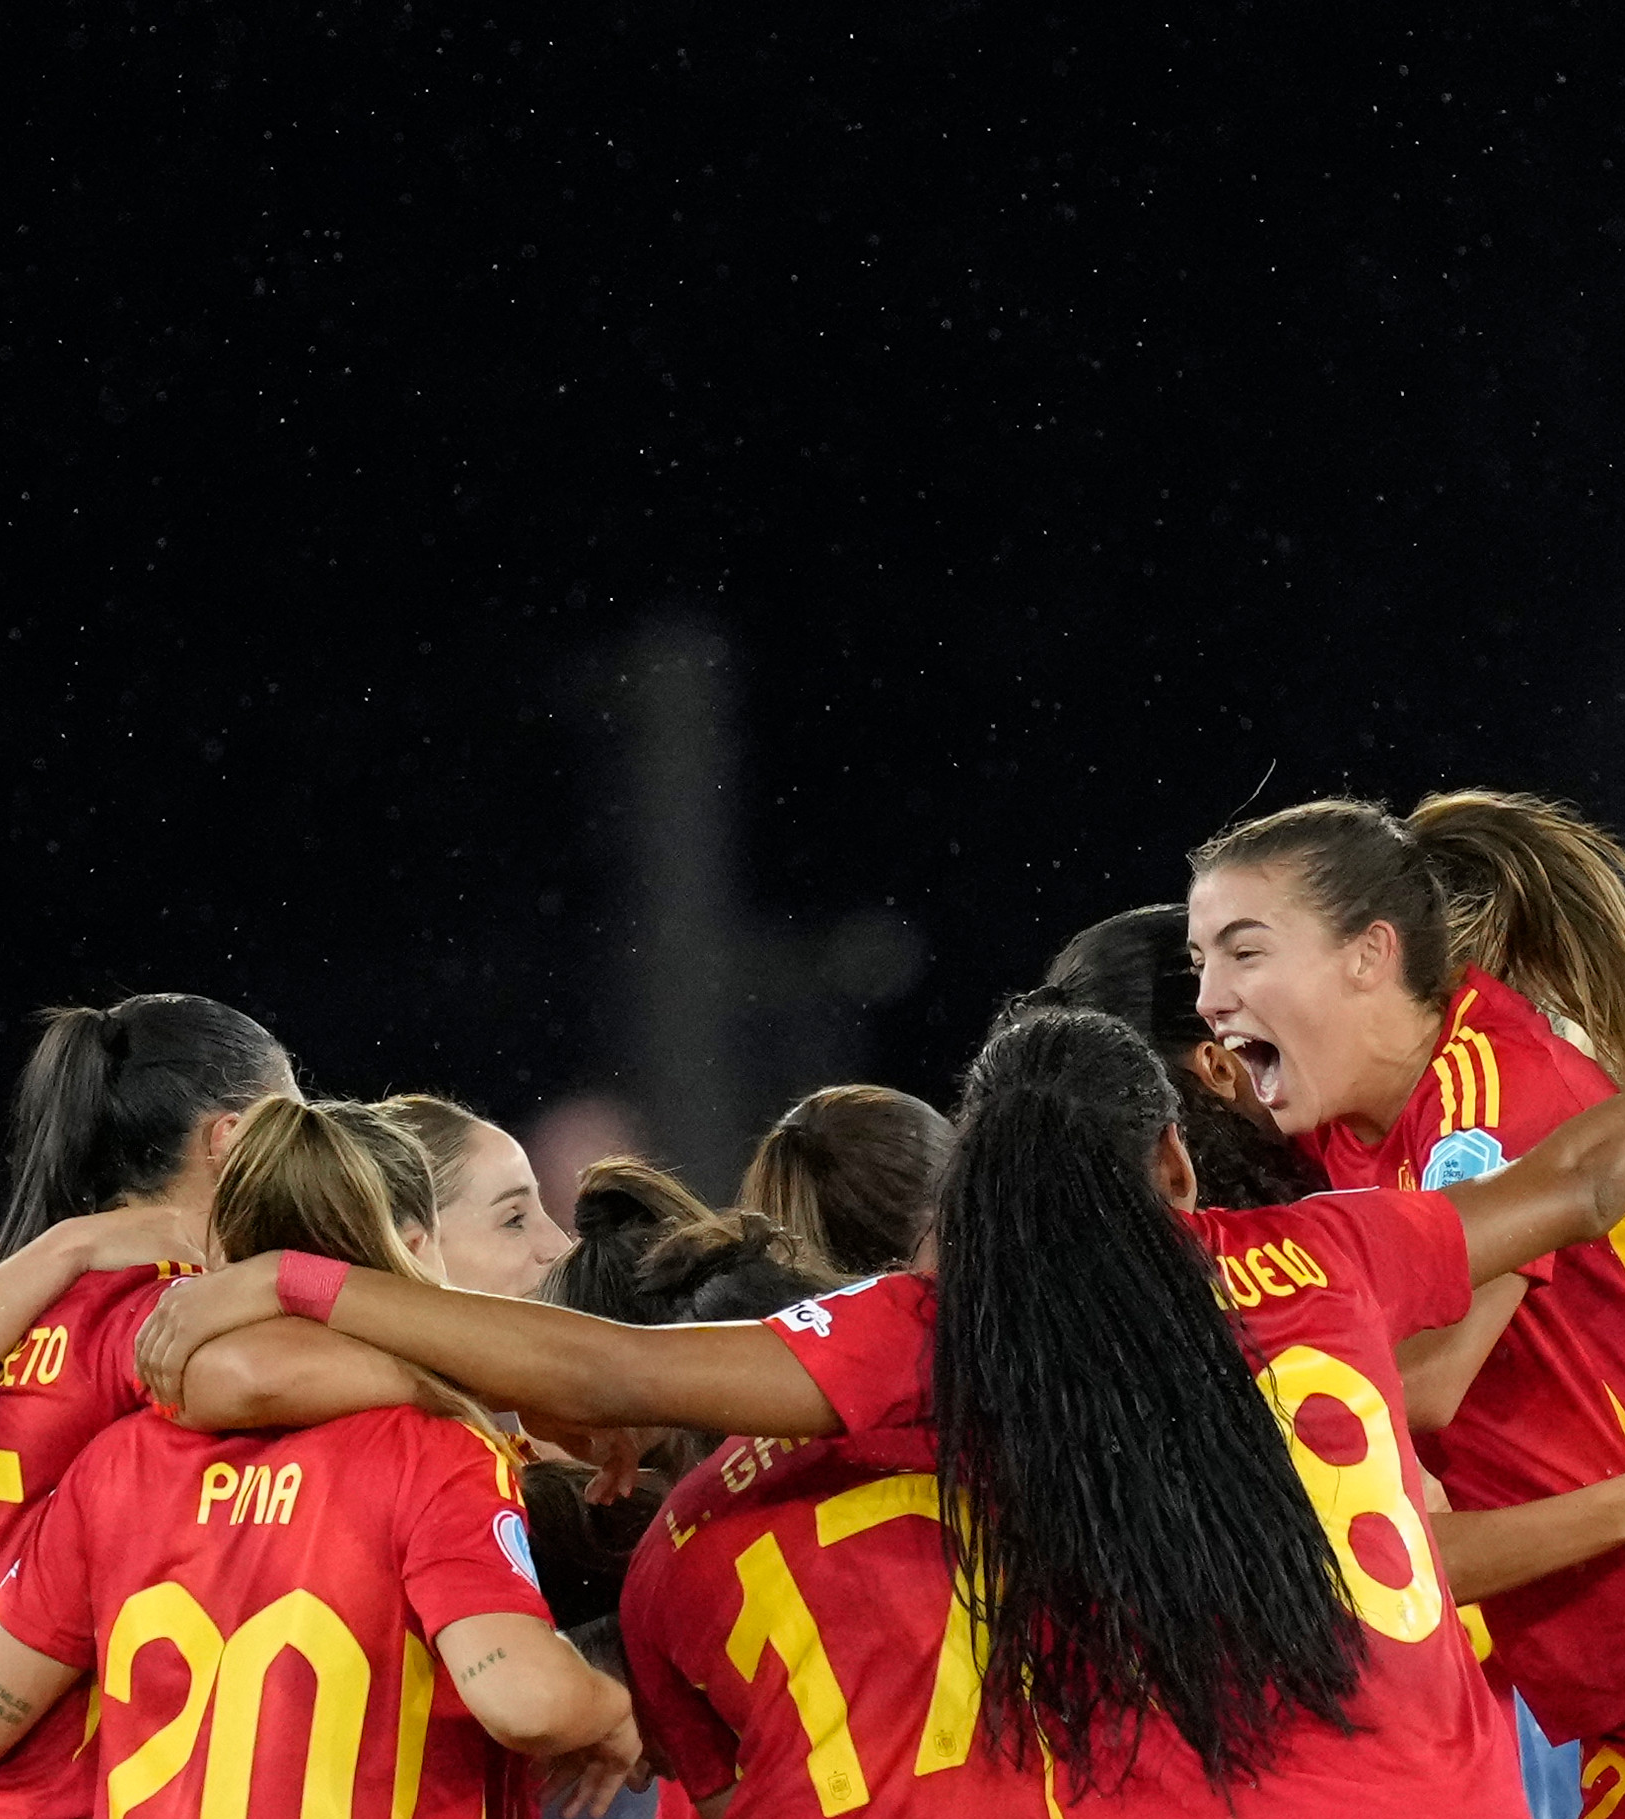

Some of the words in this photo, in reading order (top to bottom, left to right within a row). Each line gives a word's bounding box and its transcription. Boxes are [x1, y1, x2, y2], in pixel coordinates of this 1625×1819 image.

[1209, 1237, 1328, 1311] UELO
[196, 1460, 303, 1526] PINA
[724, 1472, 1004, 1819] 17
